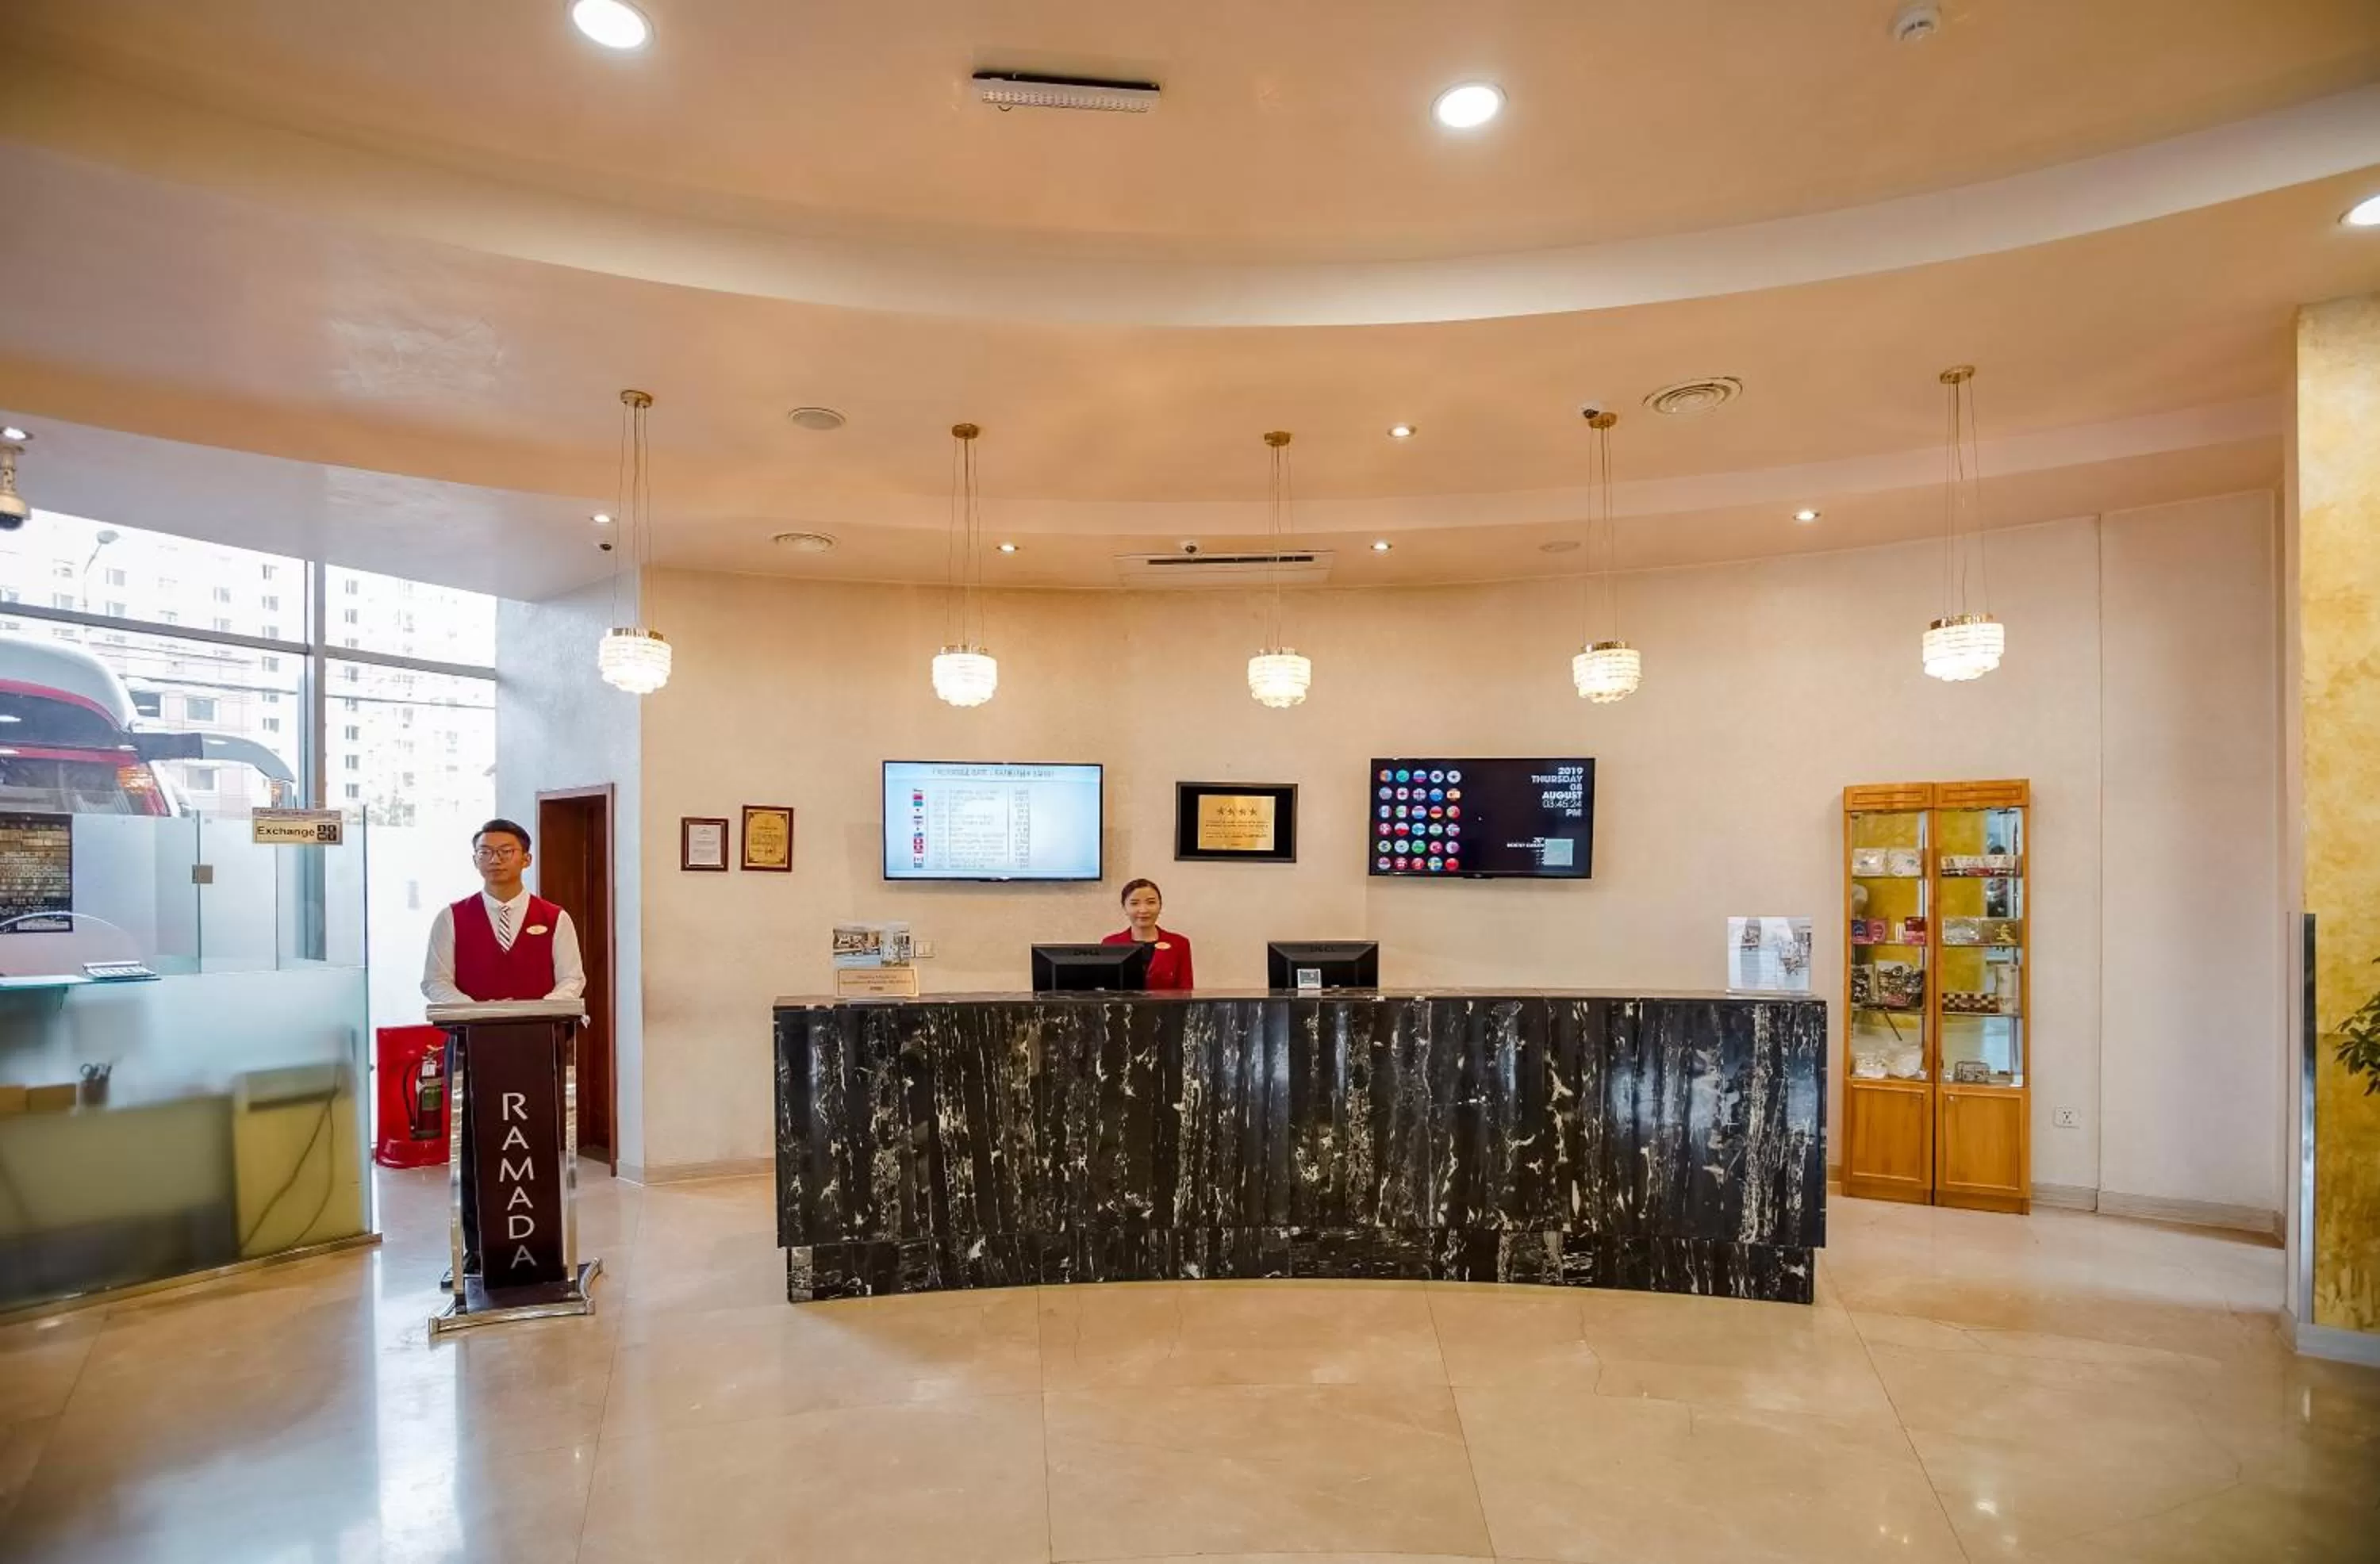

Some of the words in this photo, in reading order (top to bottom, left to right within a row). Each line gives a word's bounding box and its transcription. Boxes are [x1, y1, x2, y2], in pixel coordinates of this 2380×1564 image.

[1531, 775, 1583, 784] THURSDAY
[257, 826, 315, 838] Exchange
[498, 1092, 537, 1270] RAMADA
